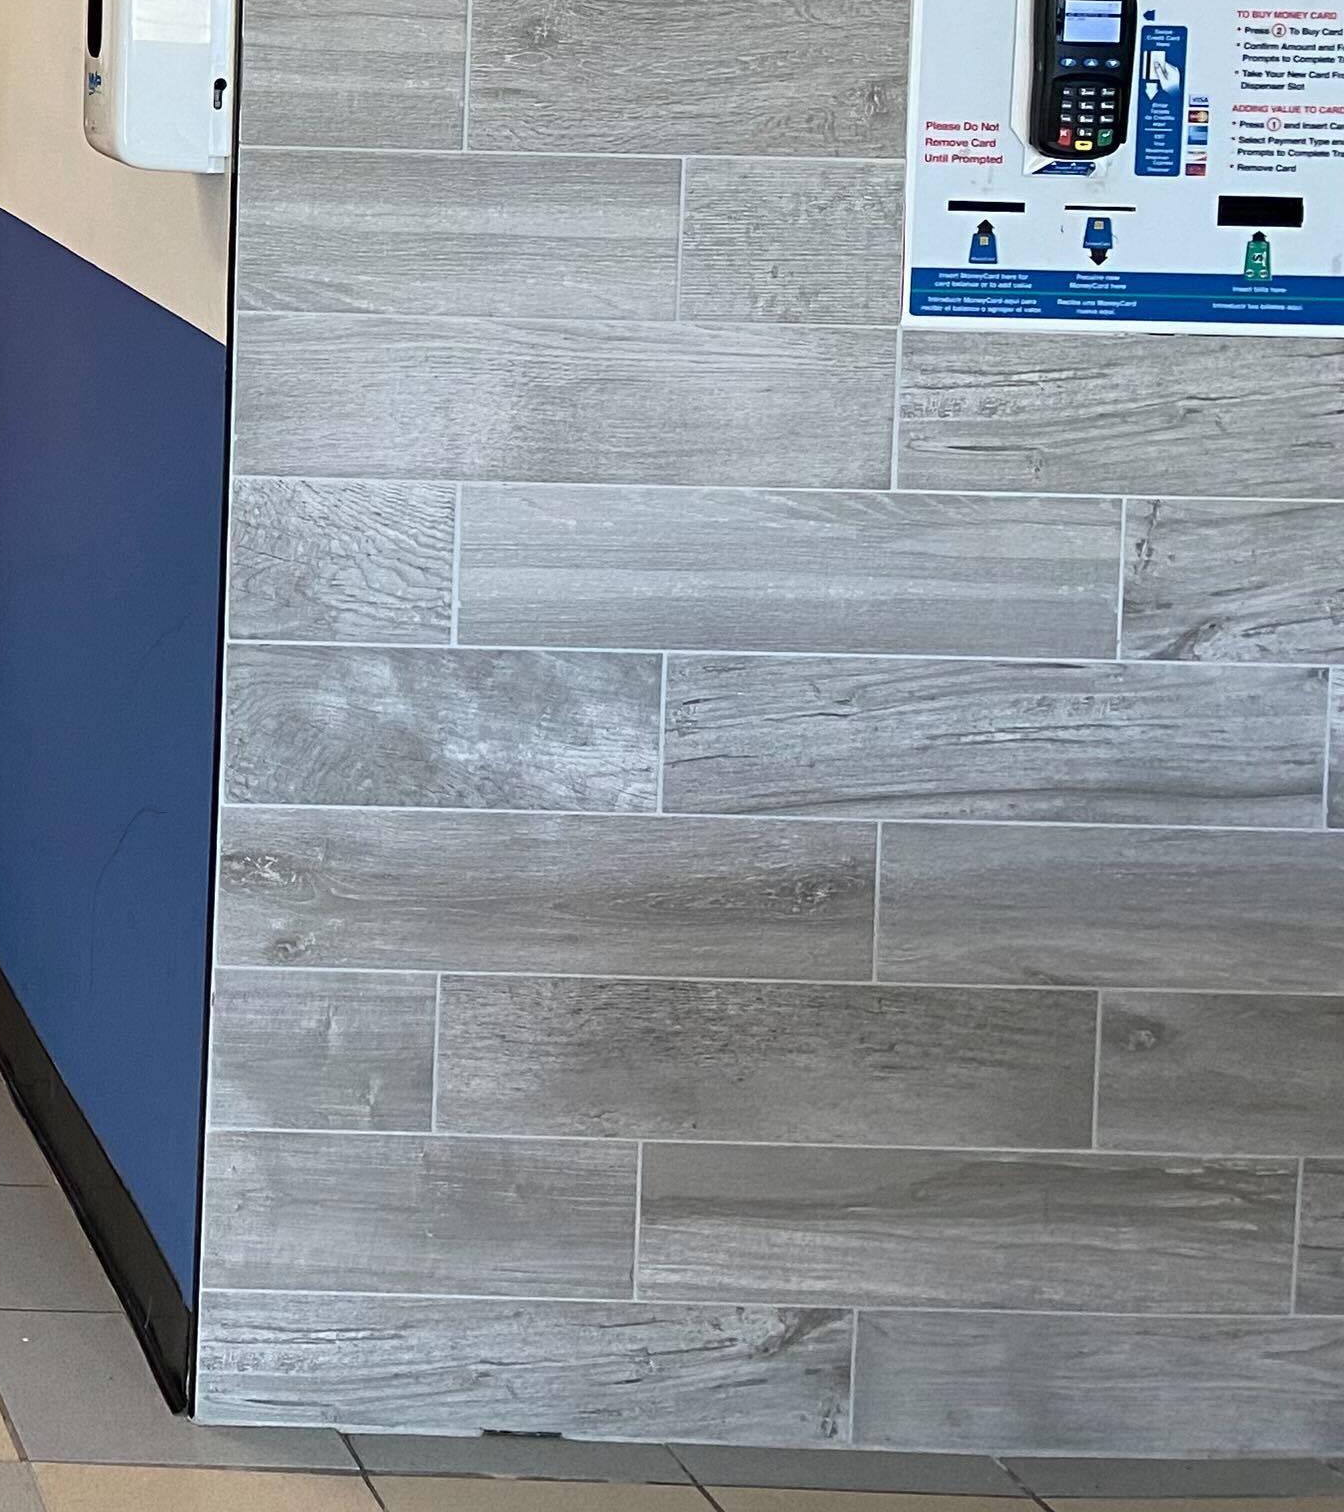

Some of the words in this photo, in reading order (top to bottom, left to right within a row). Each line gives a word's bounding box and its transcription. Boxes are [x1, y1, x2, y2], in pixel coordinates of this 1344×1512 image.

[1252, 11, 1272, 19] BUY
[1274, 11, 1308, 19] MONEY
[1289, 27, 1300, 35] To
[1302, 28, 1320, 37] Buy
[1322, 28, 1343, 36] Card
[1244, 42, 1279, 50] Confirm
[1281, 43, 1316, 51] Amount
[1242, 55, 1280, 64] Prompts
[1293, 55, 1335, 64] Complete
[1265, 70, 1285, 78] Your
[1308, 71, 1330, 79] Card
[1241, 82, 1285, 90] Dispenser
[1287, 82, 1305, 90] Slot
[1232, 105, 1268, 113] ADDING
[1271, 105, 1301, 113] VALUE
[926, 121, 961, 130] Please
[964, 122, 978, 131] Do
[981, 122, 1000, 131] Not
[925, 138, 969, 147] Remove
[971, 138, 996, 148] Card
[1268, 137, 1306, 146] Payment
[1309, 138, 1330, 146] Type
[1237, 149, 1274, 157] Prompts
[1287, 149, 1330, 158] Complete
[924, 154, 949, 163] Until
[951, 154, 1003, 165] Prompted
[1237, 164, 1273, 172] Remove
